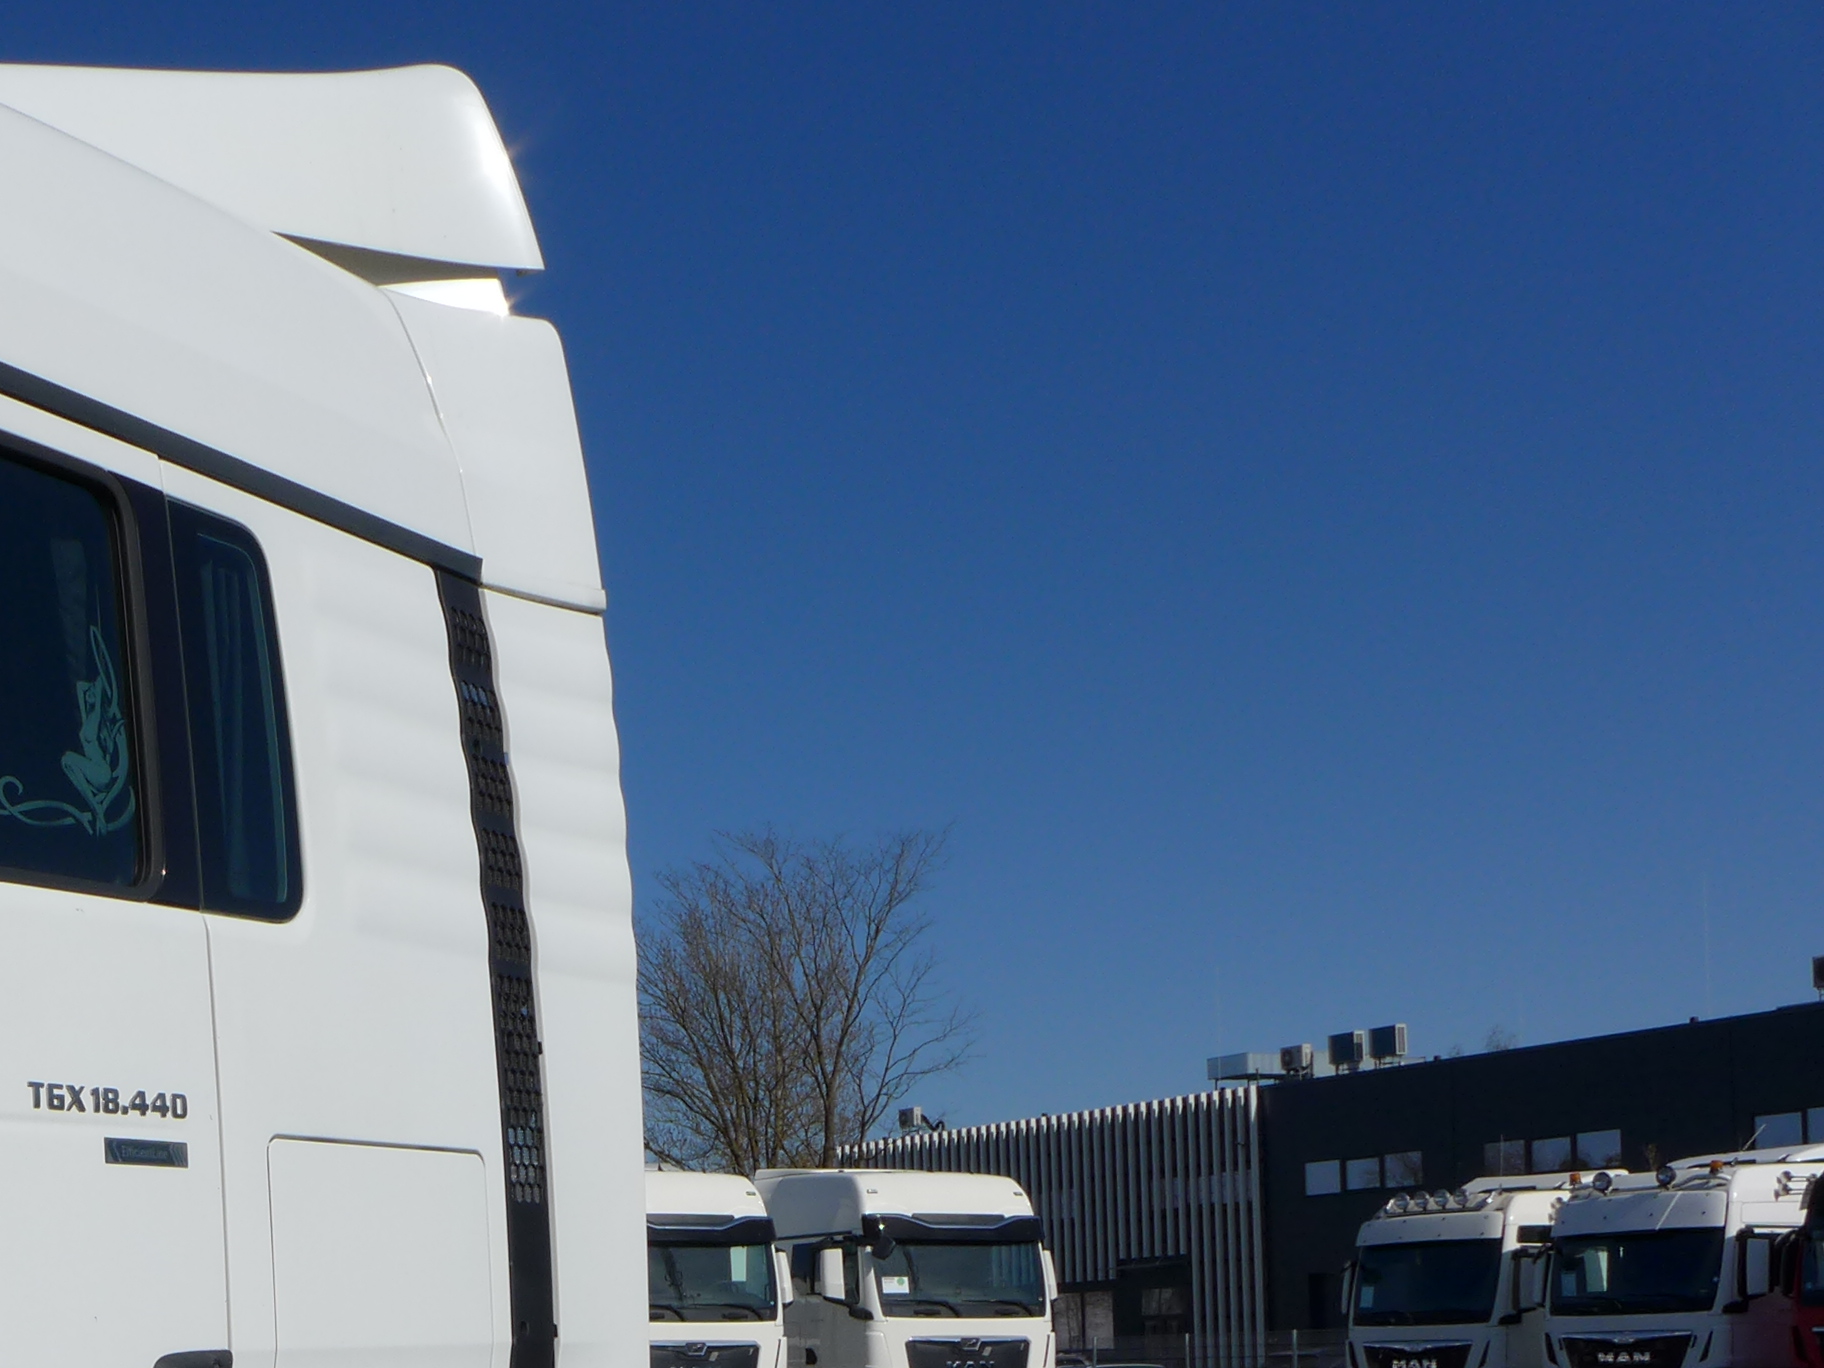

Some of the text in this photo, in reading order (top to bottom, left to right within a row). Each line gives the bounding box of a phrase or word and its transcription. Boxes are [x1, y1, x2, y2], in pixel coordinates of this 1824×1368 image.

[27, 1081, 188, 1119] TGX 18.440
[1597, 1351, 1651, 1364] MAN
